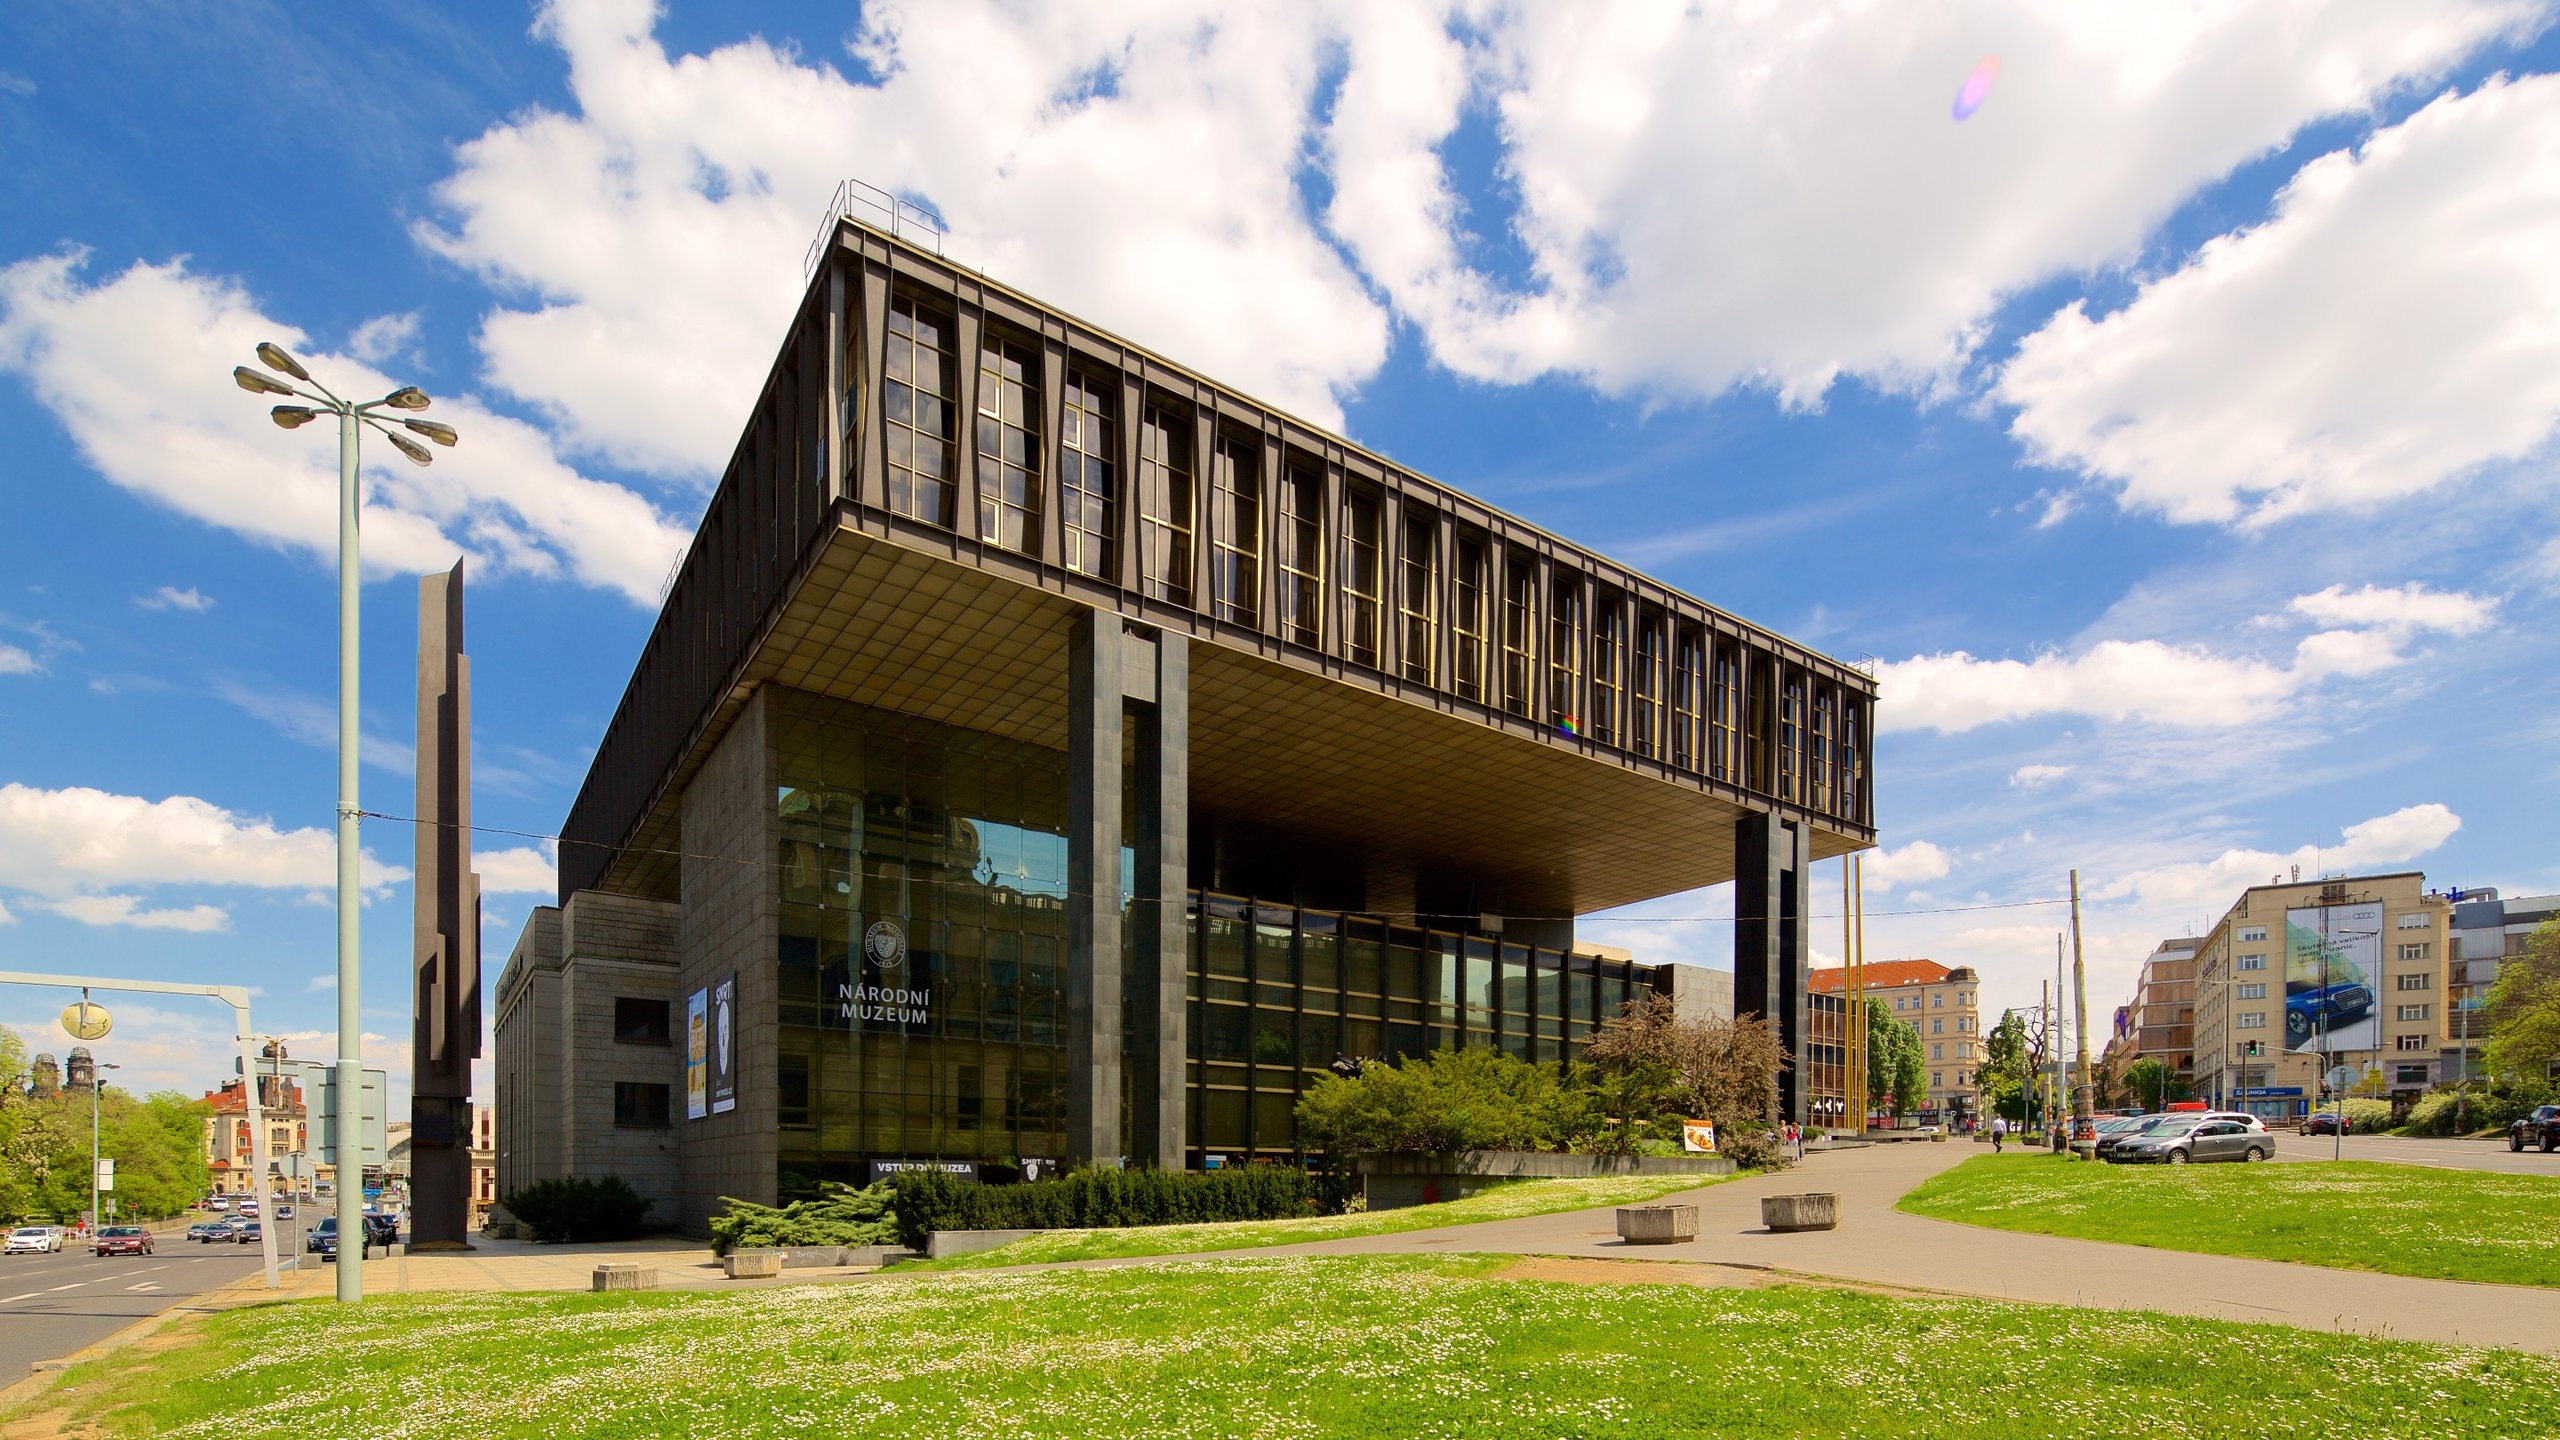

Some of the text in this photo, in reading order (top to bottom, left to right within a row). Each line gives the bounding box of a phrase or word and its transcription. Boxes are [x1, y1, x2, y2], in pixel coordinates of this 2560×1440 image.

[2297, 934, 2375, 951] Skutená velikost
[840, 982, 930, 1006] NÁRODNÍ
[841, 1003, 927, 1025] MUZEUM
